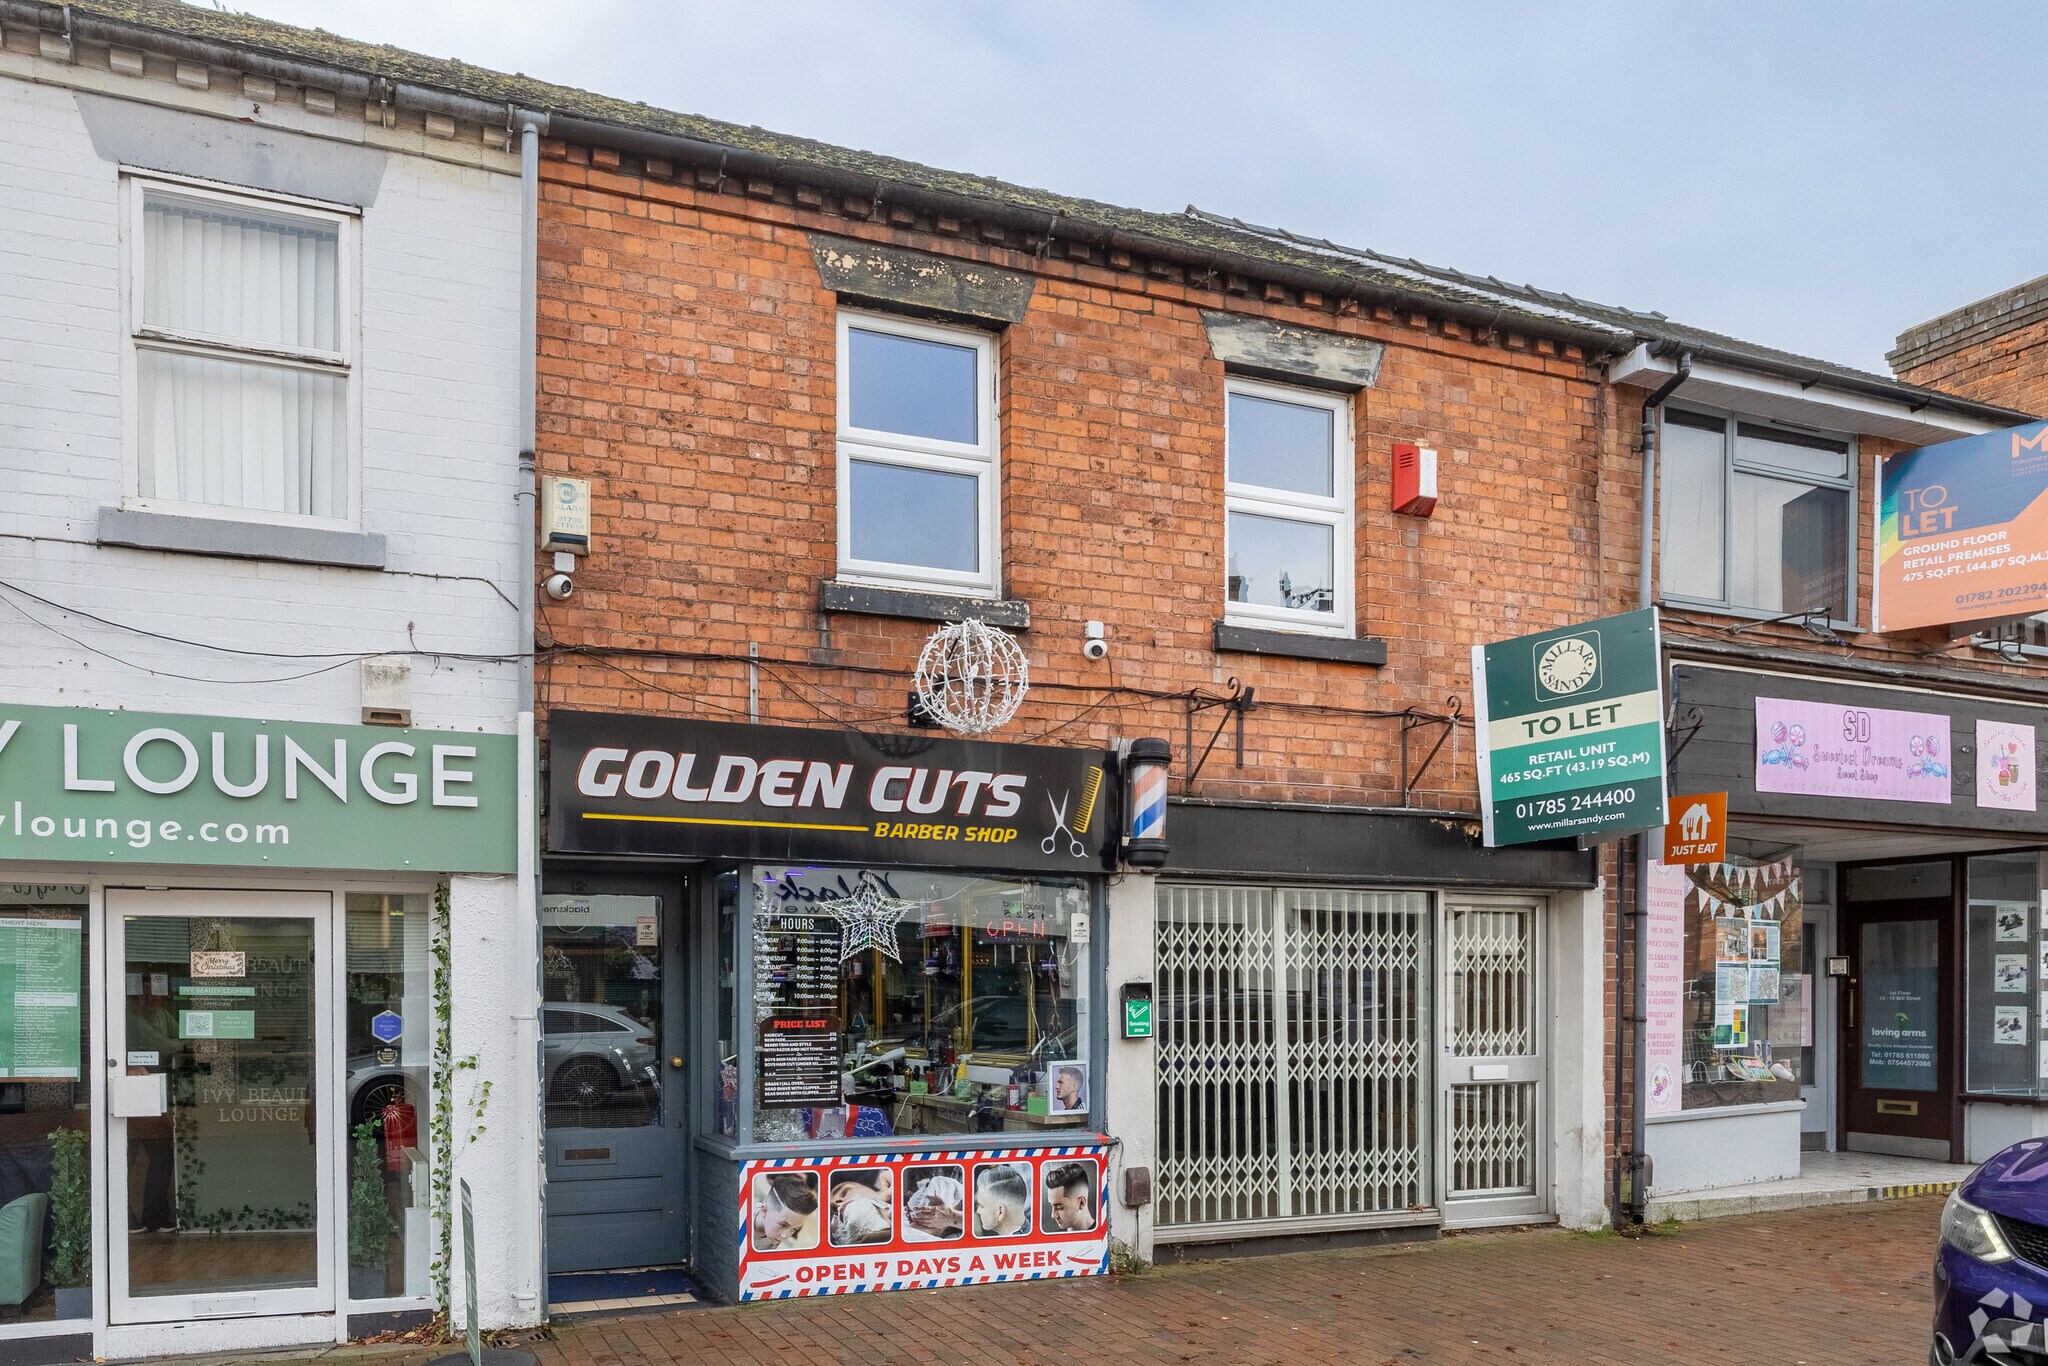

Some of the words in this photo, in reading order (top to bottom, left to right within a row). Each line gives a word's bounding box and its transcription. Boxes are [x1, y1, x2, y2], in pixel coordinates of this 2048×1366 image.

[1904, 485, 1948, 512] TO
[1903, 505, 1959, 537] LET
[1903, 539, 1960, 557] GROUND
[1963, 531, 2008, 546] FLOOR
[1903, 555, 1945, 570] RETAIL
[1948, 543, 2011, 563] PREMISES
[1902, 572, 1924, 582] 475
[1926, 565, 1964, 579] SQ.FT.
[1966, 558, 2006, 573] (44.87
[1955, 590, 1993, 604] 01782
[1996, 583, 2048, 598] 202294
[1542, 641, 1594, 671] MILLAR
[1543, 666, 1593, 692] SANDY
[1522, 715, 1561, 738] TO
[1569, 703, 1622, 731] LET
[1843, 710, 1871, 743] SD
[64, 723, 478, 807] LOUNGE
[1529, 749, 1577, 766] RETAIL
[1580, 742, 1617, 757] UNIT
[1813, 744, 1858, 767] Sweetest
[1500, 771, 1521, 784] 465
[1523, 765, 1563, 781] SQ.FT
[1566, 758, 1605, 776] (43.19
[1607, 751, 1651, 768] SQ.M)
[1860, 769, 1879, 784] Shop
[576, 747, 854, 810] GOLDEN
[867, 766, 1027, 818] CUTS
[1516, 797, 1566, 819] 01785
[1571, 787, 1636, 811] 244400
[874, 822, 960, 842] BARBER
[963, 826, 1018, 844] SHOP
[1528, 811, 1625, 832] www.millarsandy.com
[1671, 844, 1696, 857] JUST
[1697, 843, 1718, 854] EAT
[1654, 887, 1683, 896] CHOCOLATE
[1661, 901, 1679, 909] COFFEE
[781, 918, 815, 930] HOURS
[201, 963, 235, 971] Christmas
[207, 957, 230, 965] Merry
[247, 958, 307, 974] BEAUT
[774, 1020, 803, 1029] PRICE
[805, 1020, 827, 1028] LIST
[1871, 1027, 1900, 1038] loving
[203, 1089, 236, 1104] IVY
[248, 1088, 307, 1102] BEAUT
[219, 1108, 300, 1123] LOUNGE
[796, 1263, 865, 1283] OPEN
[874, 1261, 888, 1278] 7
[897, 1257, 961, 1277] DAYS
[969, 1255, 985, 1271] A
[993, 1250, 1062, 1269] WEEK
